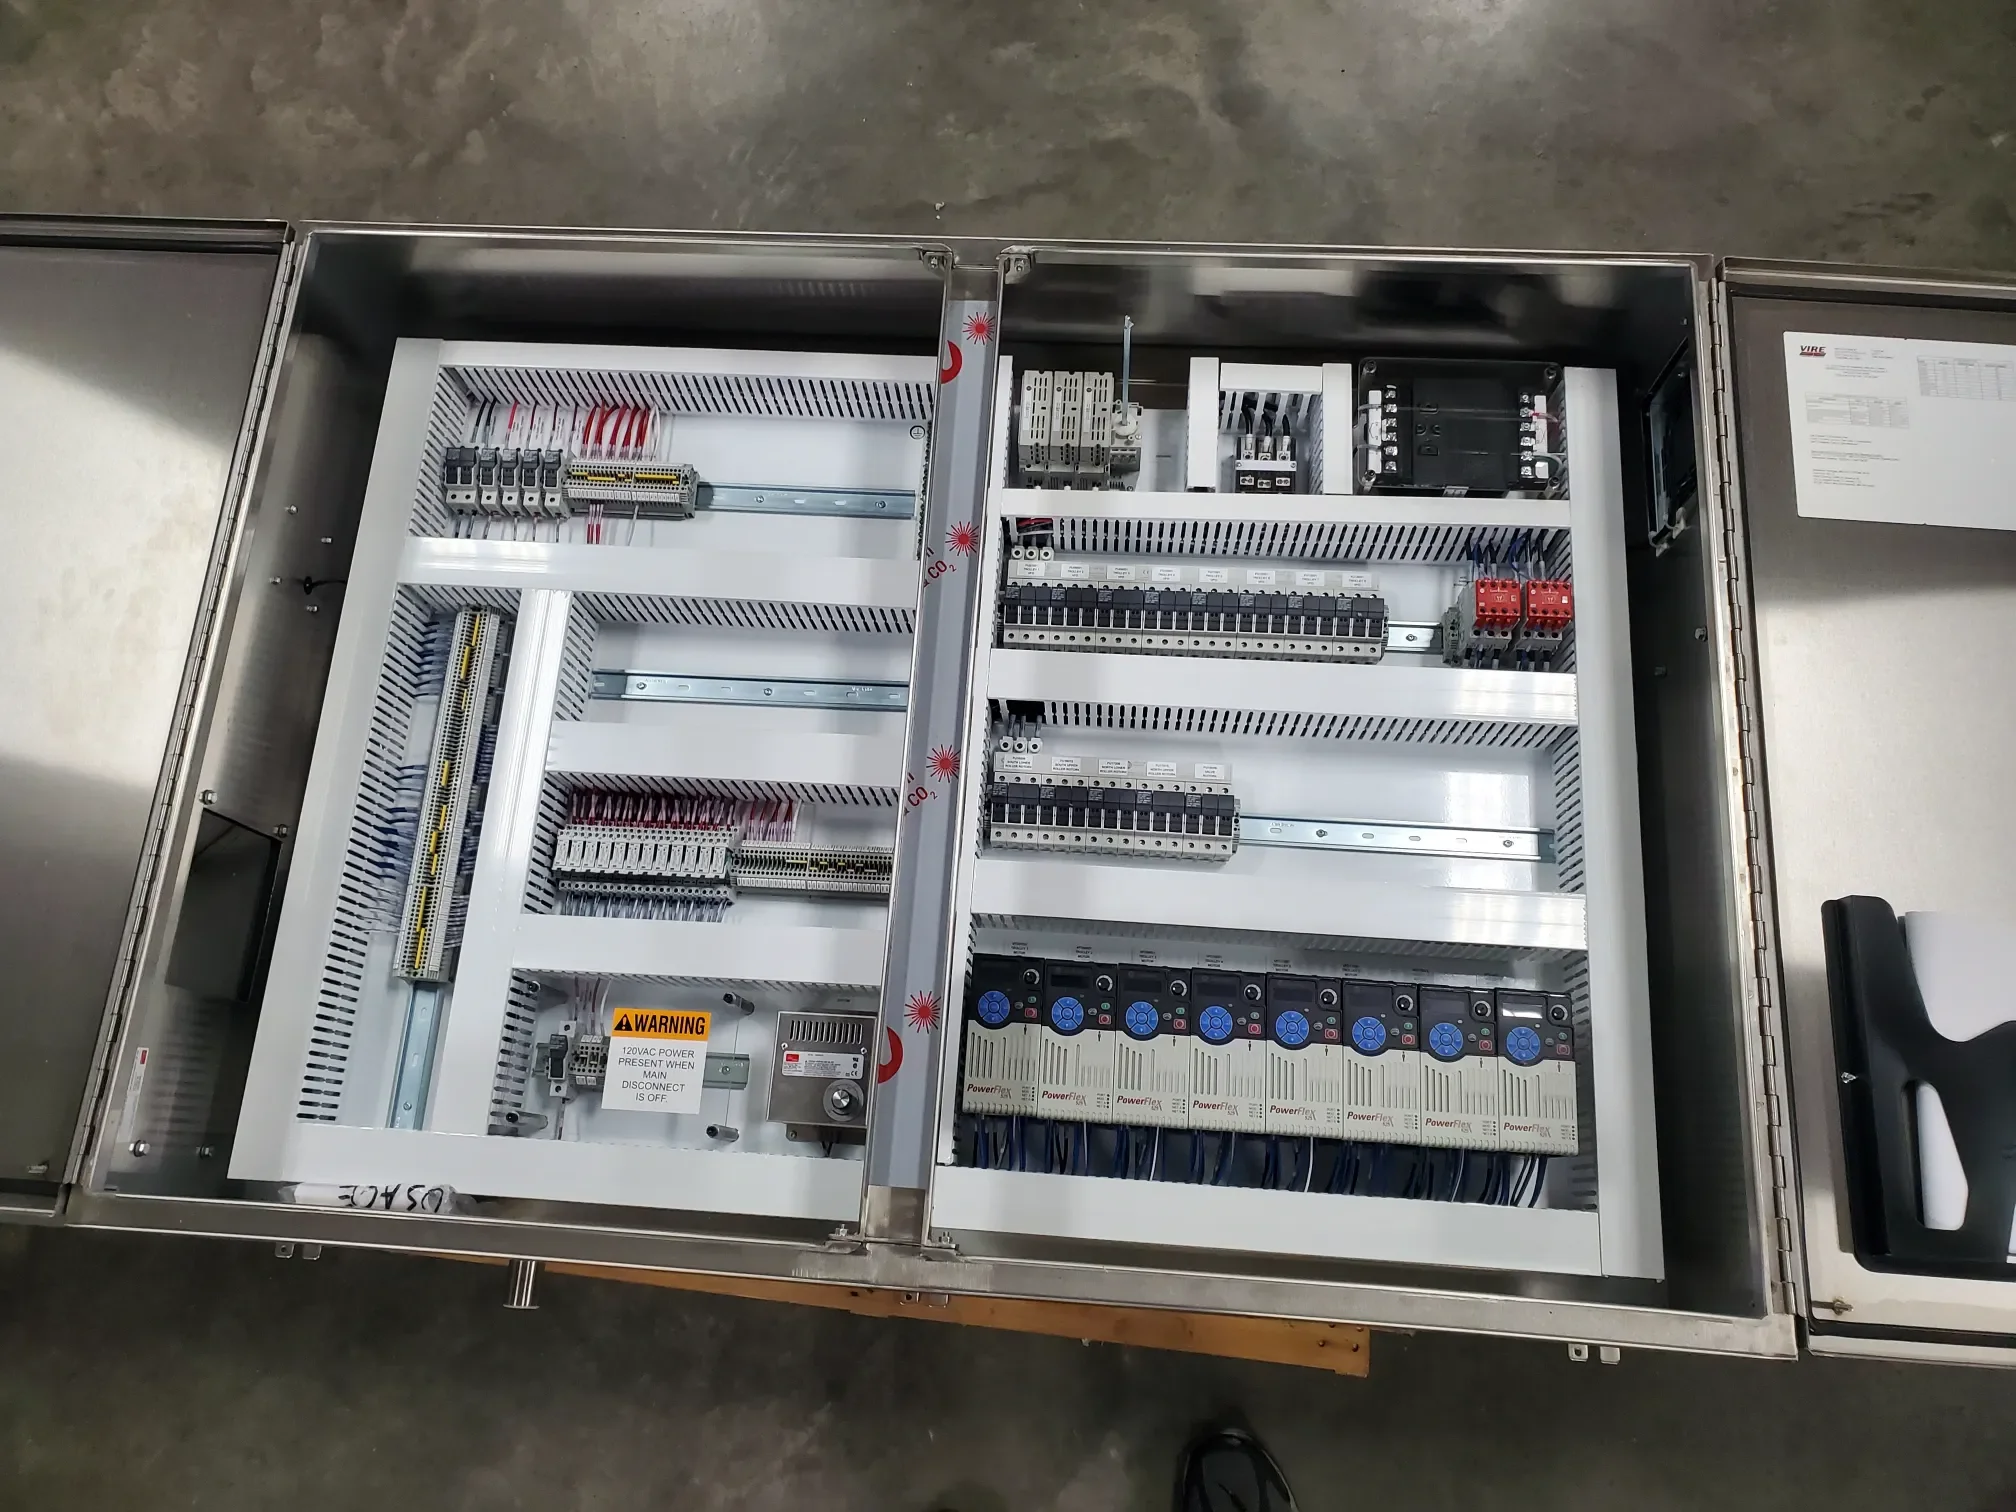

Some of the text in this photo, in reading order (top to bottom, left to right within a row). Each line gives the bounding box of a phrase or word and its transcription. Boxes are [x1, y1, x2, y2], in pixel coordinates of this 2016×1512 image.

[1800, 345, 1826, 353] VIRE
[634, 1014, 706, 1035] WARNING
[622, 1046, 695, 1058] 120VAC POWER
[618, 1058, 695, 1070] PRESENT WHEN
[643, 1071, 668, 1080] MAIN
[621, 1081, 685, 1092] DISCONNECT
[967, 1083, 1012, 1099] PowerFlex
[635, 1093, 668, 1103] IS OFF.
[1041, 1090, 1087, 1106] PowerFlex
[1116, 1095, 1163, 1111] PowerFlex
[1192, 1100, 1239, 1116] PowerFlex
[1270, 1105, 1317, 1121] PowerFlex
[1347, 1111, 1394, 1127] PowerFlex
[1425, 1117, 1472, 1134] PowerFlex
[1503, 1122, 1551, 1138] PowerFlex
